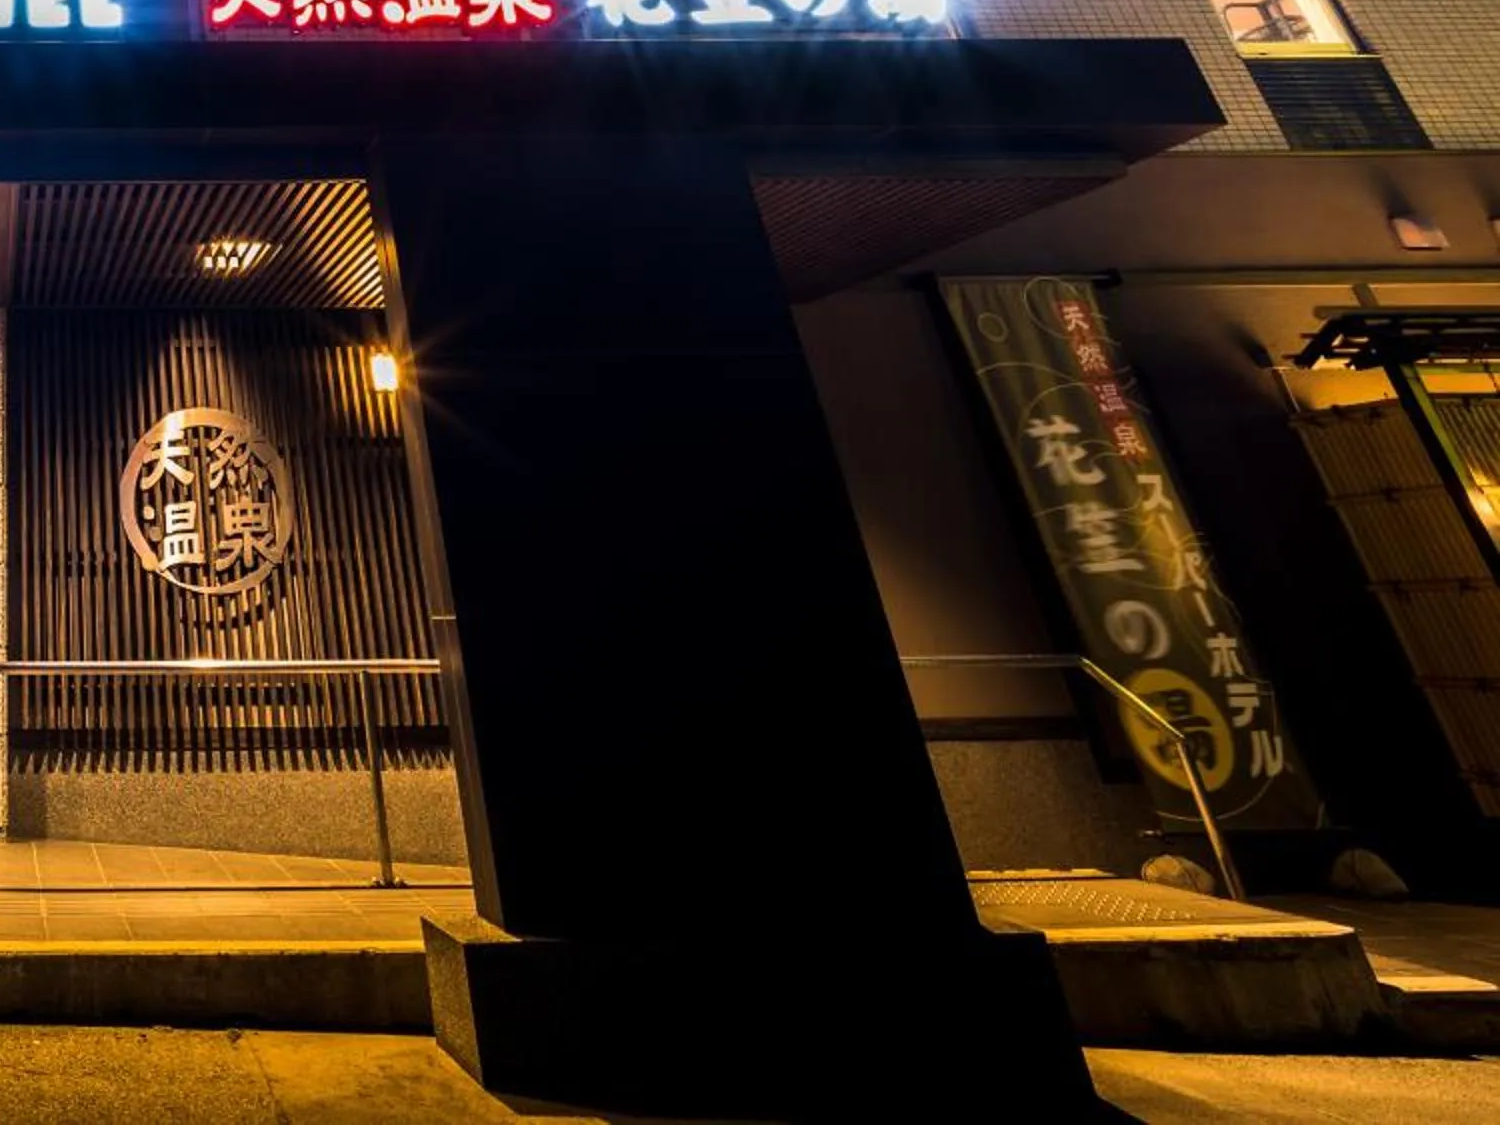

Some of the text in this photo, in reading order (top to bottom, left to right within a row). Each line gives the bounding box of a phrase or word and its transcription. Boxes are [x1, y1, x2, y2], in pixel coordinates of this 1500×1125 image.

[1061, 305, 1147, 457] 天然温泉
[140, 495, 283, 572] 温泉
[1135, 474, 1284, 778] スーパーホテル
